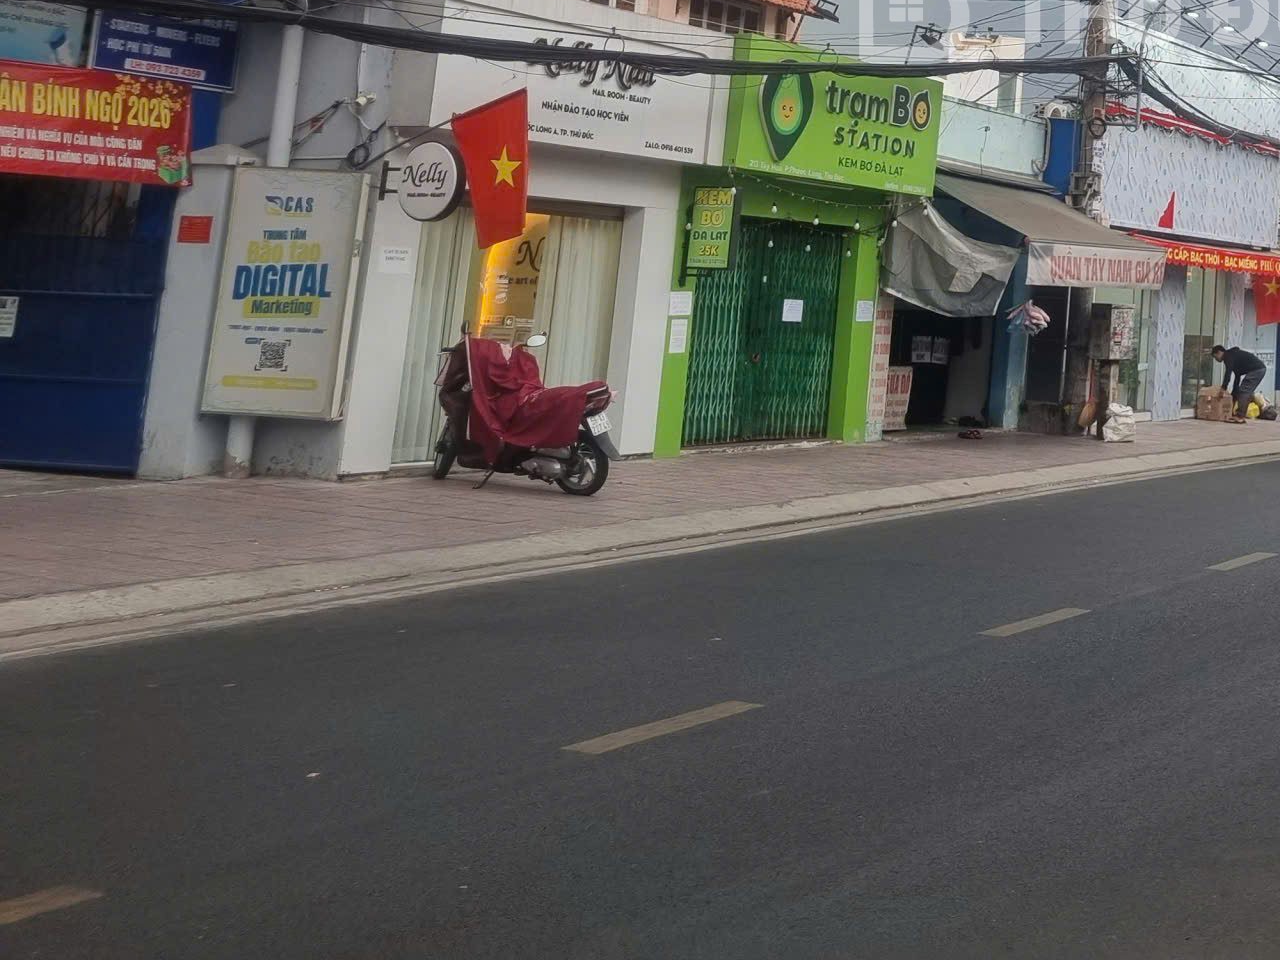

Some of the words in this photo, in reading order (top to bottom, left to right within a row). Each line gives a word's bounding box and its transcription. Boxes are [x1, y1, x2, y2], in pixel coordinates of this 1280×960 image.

[32, 77, 81, 119] BÍNH
[85, 88, 124, 131] NGỌ
[127, 95, 172, 129] 2026
[833, 126, 916, 158] STATION
[402, 162, 449, 190] Nelly
[838, 156, 858, 170] KEM
[874, 160, 888, 173] ĐÀ
[696, 190, 732, 206] KEM
[698, 244, 719, 257] 25K
[231, 263, 332, 301] DIGITAL
[1084, 252, 1104, 283] TÂY
[1107, 258, 1133, 284] NAM
[251, 297, 314, 316] Marketing
